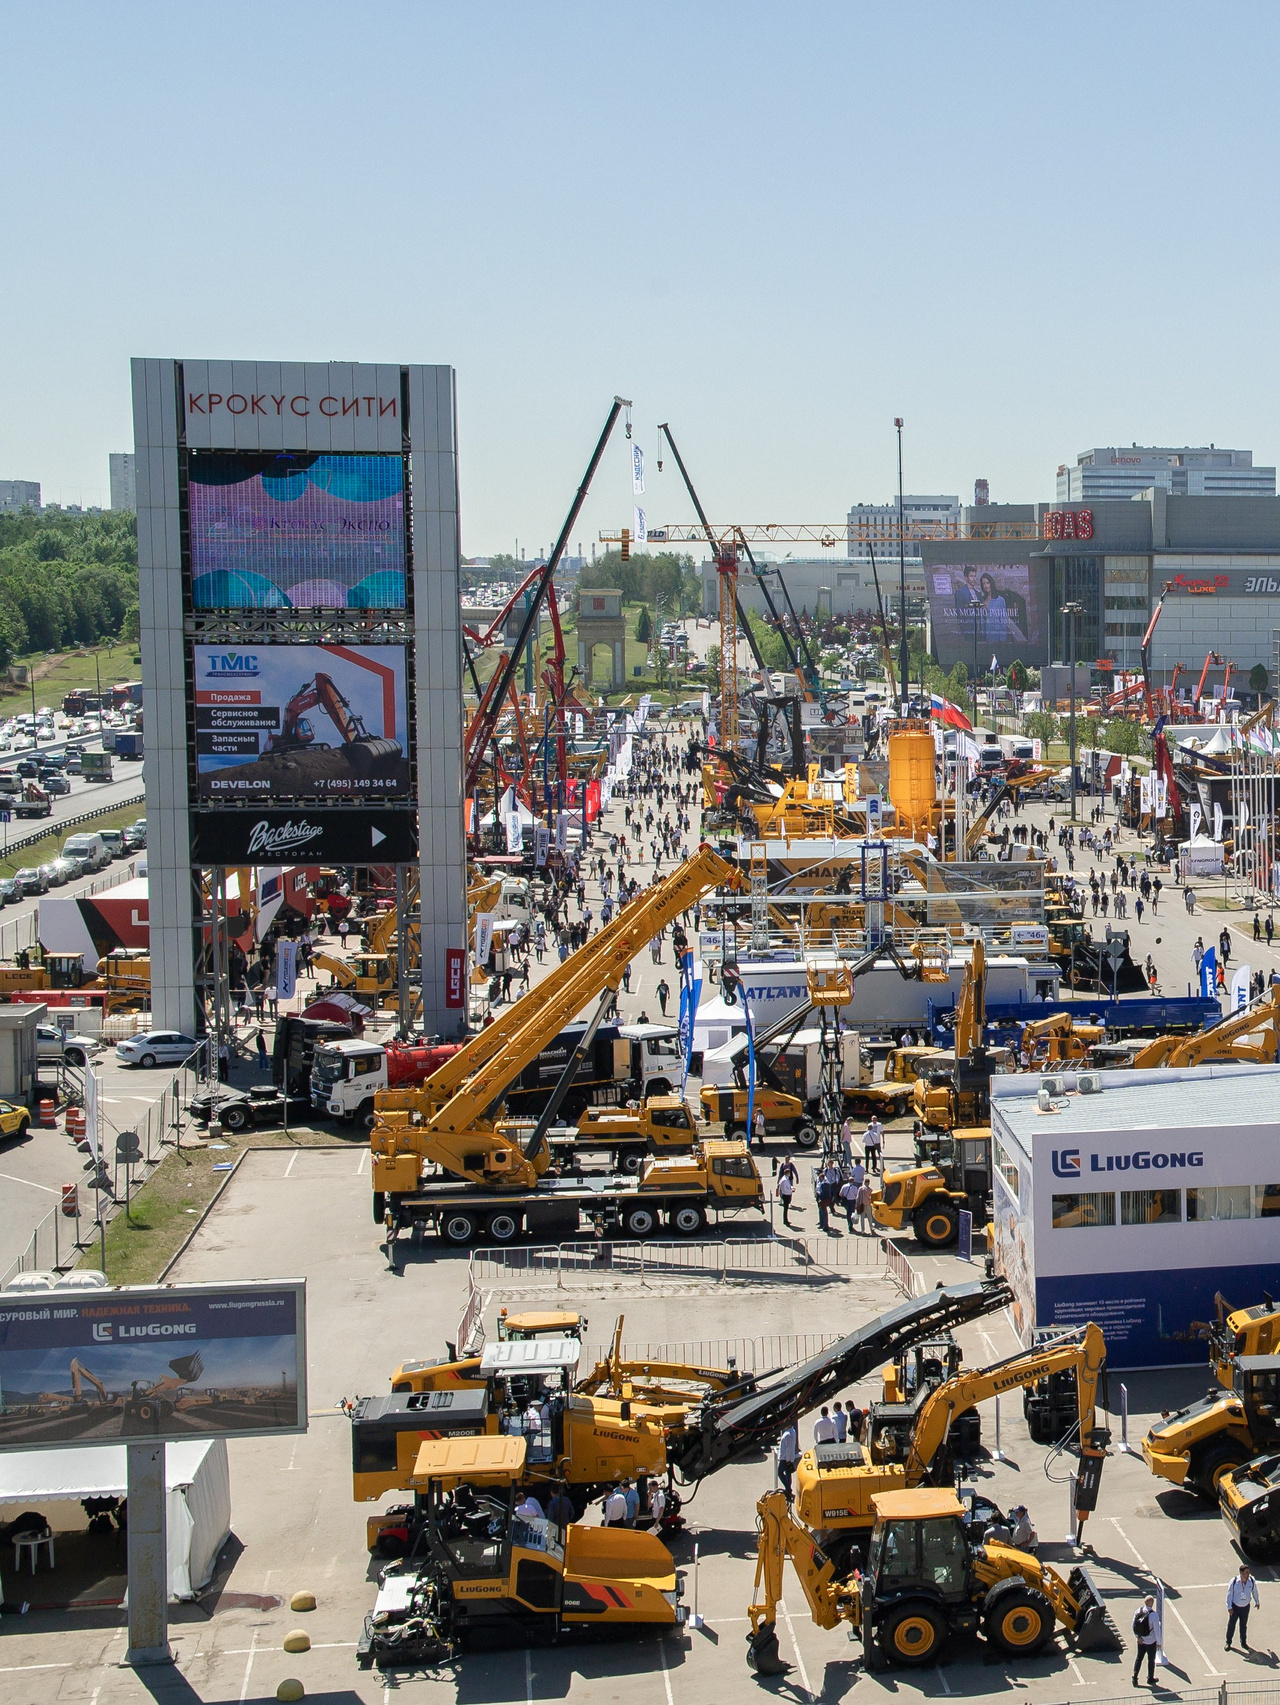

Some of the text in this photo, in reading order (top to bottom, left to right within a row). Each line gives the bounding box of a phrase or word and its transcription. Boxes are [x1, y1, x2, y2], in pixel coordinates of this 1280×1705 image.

[189, 393, 397, 418] КРОКУС СИТИ
[1110, 456, 1141, 464] Lenovo
[1213, 574, 1230, 587] 22
[943, 607, 958, 617] КАК
[210, 693, 252, 703] Продажа
[211, 709, 259, 718] Сервисное
[211, 718, 277, 728] обслуживание
[211, 735, 256, 743] Запасные
[211, 780, 270, 789] DEVELON
[313, 779, 397, 789] +7 (495) 149 34 64
[247, 819, 323, 855] Backstage
[450, 957, 461, 1000] LGCE
[745, 986, 809, 1000] ATLANT
[1090, 1150, 1204, 1172] LiuGong
[208, 1300, 284, 1309] www.liugongrussia.ru
[0, 1303, 192, 1322] СУРОВЫЙ МИР. НАДЕЖНАЯ ТЕХНИКА.
[118, 1323, 196, 1337] LiuGong
[824, 1510, 848, 1518] W915E
